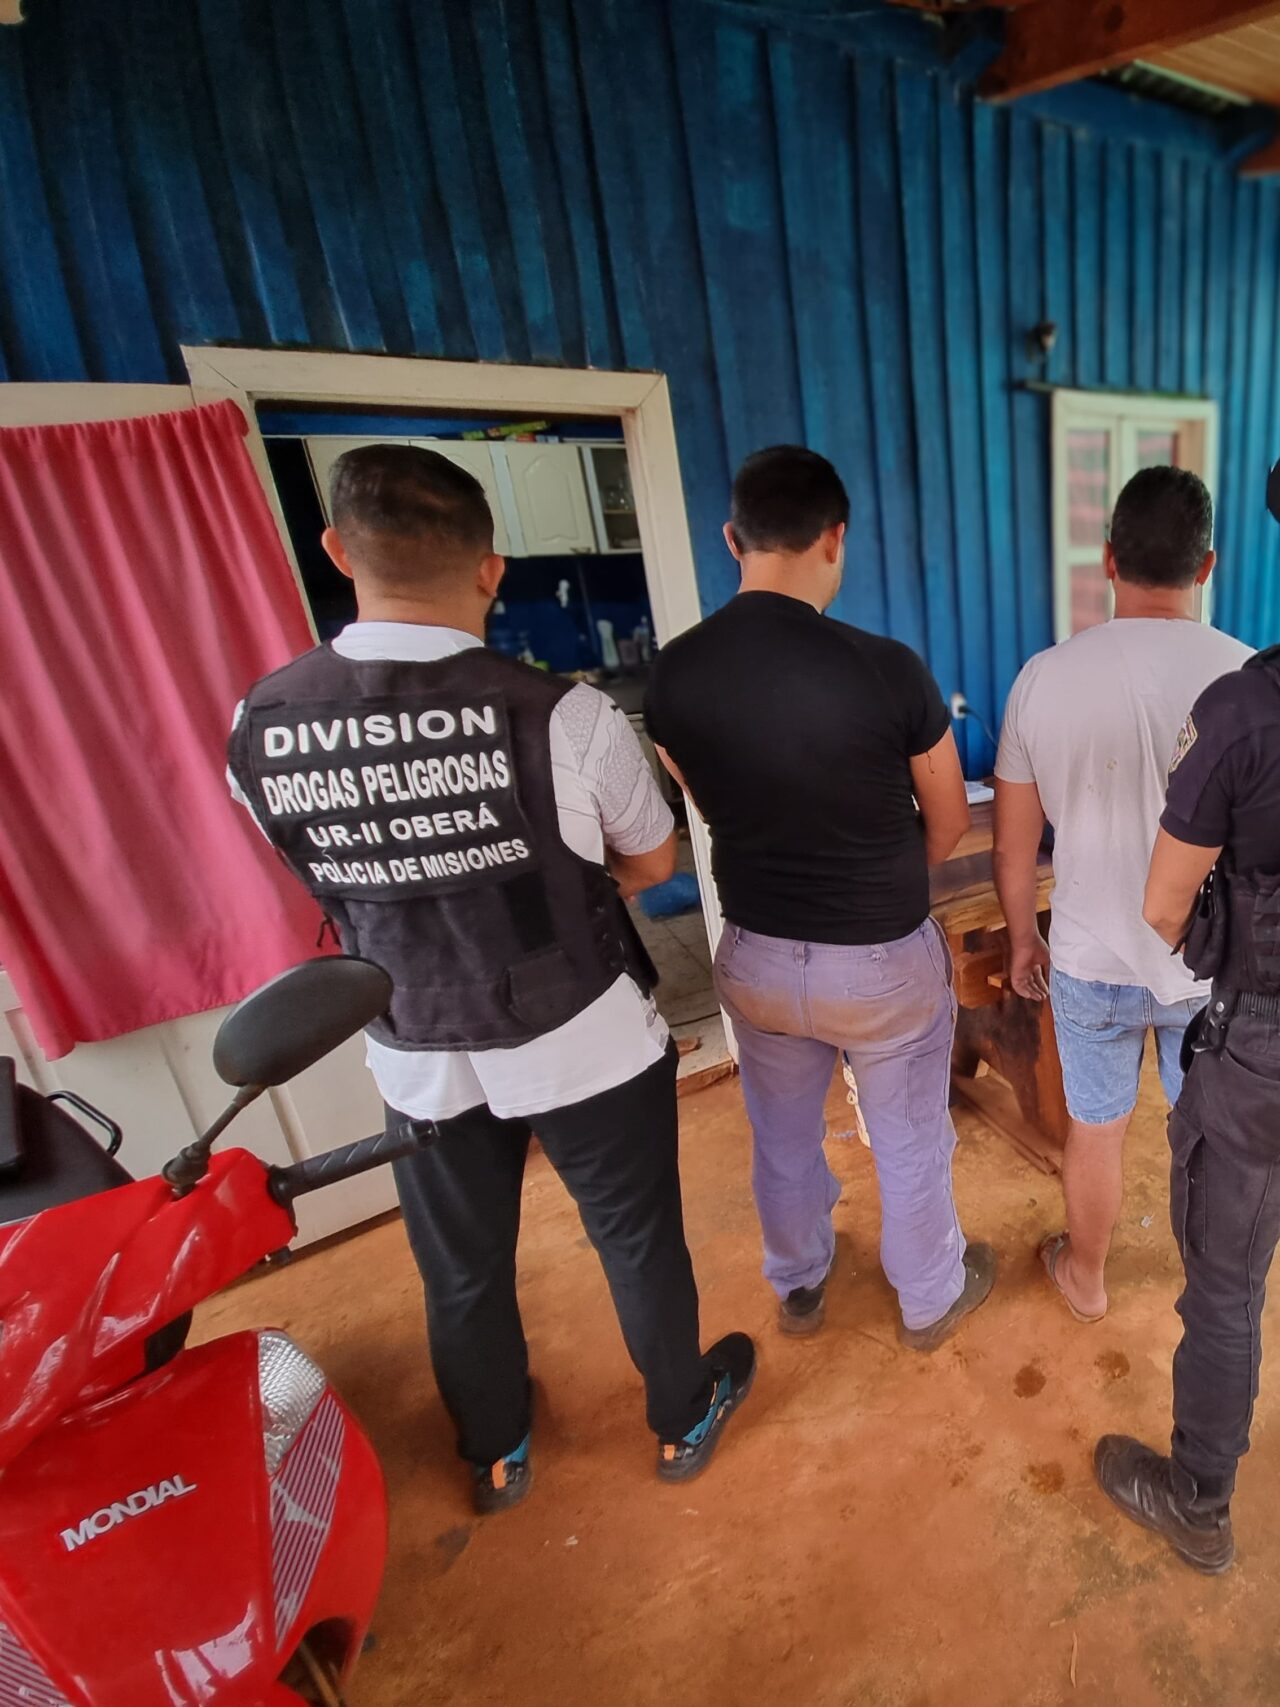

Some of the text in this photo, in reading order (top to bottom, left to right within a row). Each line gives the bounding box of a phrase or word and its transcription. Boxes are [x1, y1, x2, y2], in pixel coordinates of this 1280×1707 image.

[264, 705, 497, 758] DIVISION
[261, 750, 511, 815] DROGAS PELIGROSAS
[307, 802, 499, 848] UR-II OBERÁ
[308, 838, 530, 885] POLICIA DE MISIONES
[60, 1474, 197, 1551] MONDIAL
